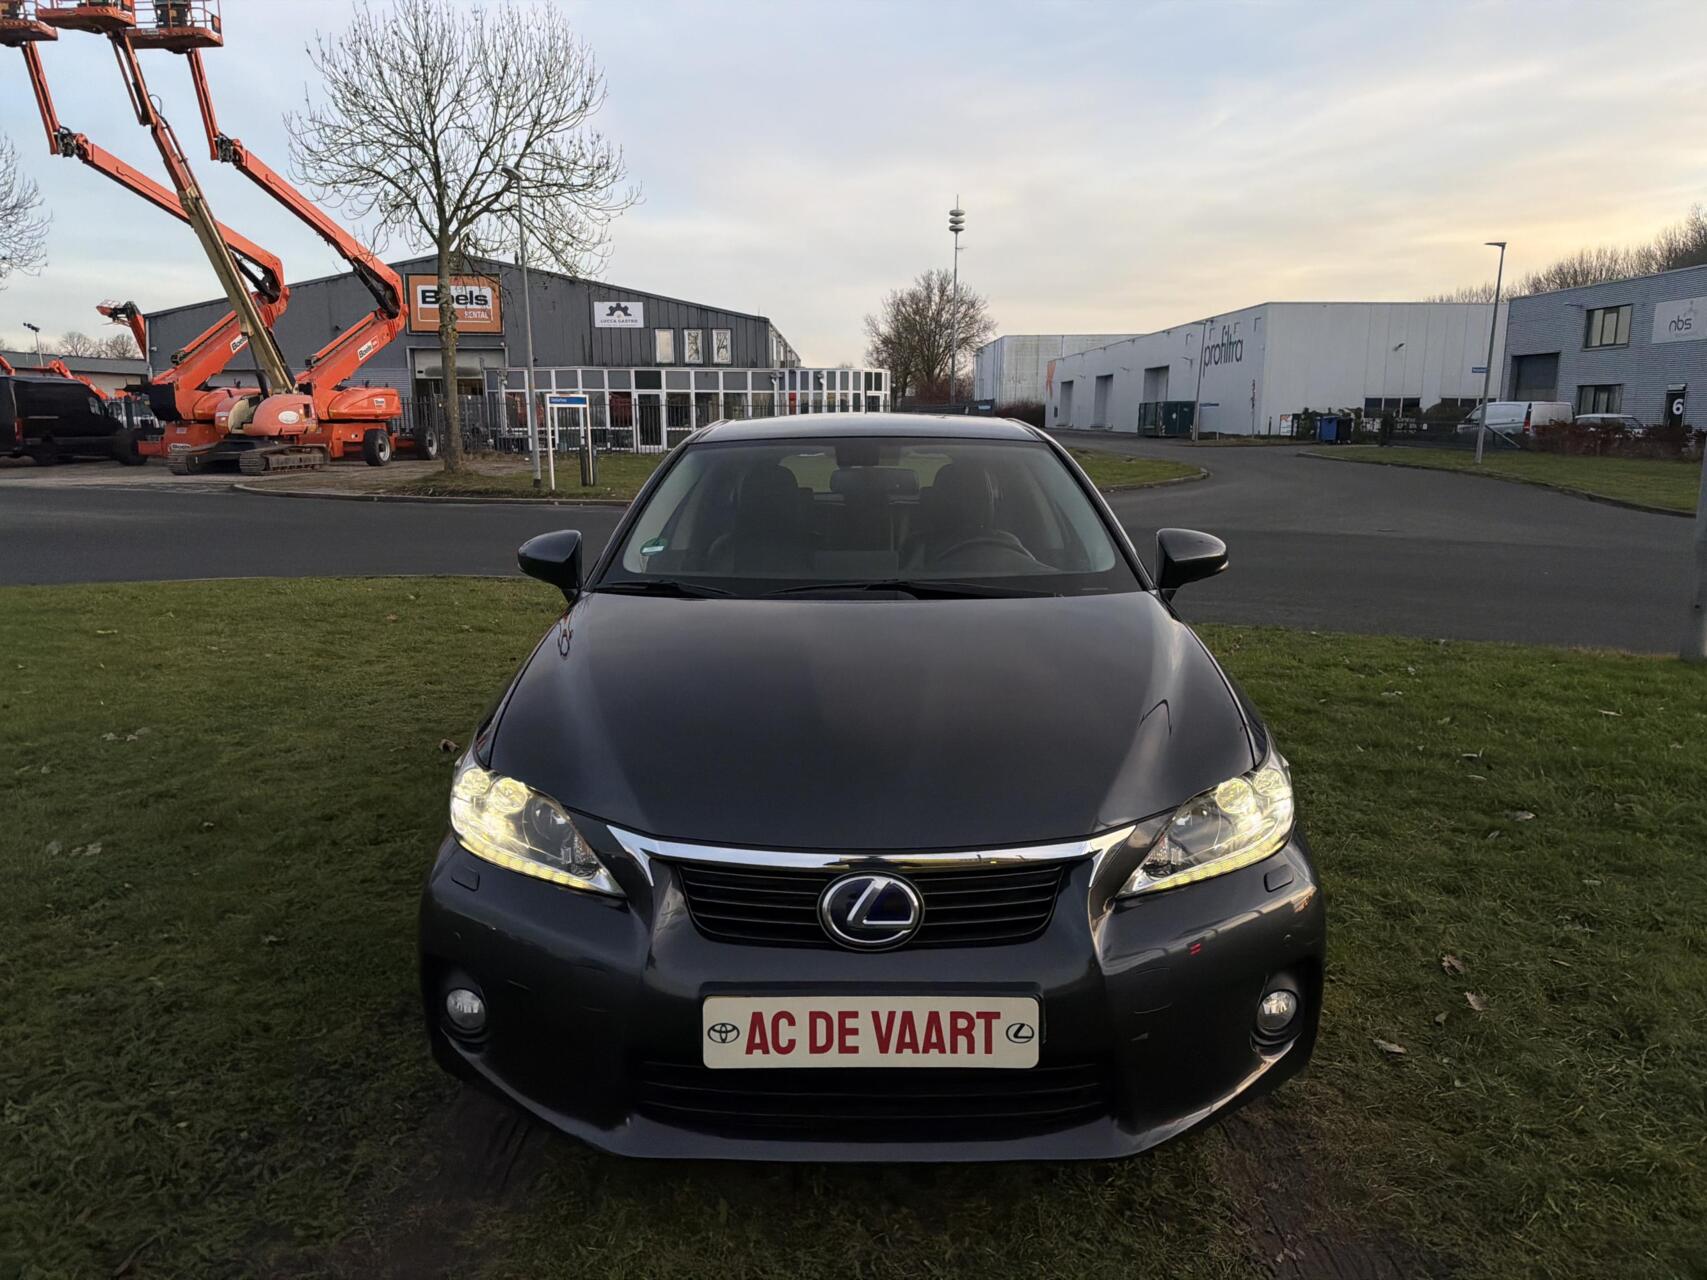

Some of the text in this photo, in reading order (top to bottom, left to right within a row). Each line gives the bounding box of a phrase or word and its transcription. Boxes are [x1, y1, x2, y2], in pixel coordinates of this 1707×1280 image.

[421, 290, 488, 306] Bels
[1669, 315, 1692, 332] nbs
[1203, 326, 1243, 377] profiltra
[1672, 398, 1684, 415] 6
[745, 1010, 1001, 1055] AC DE VAART
